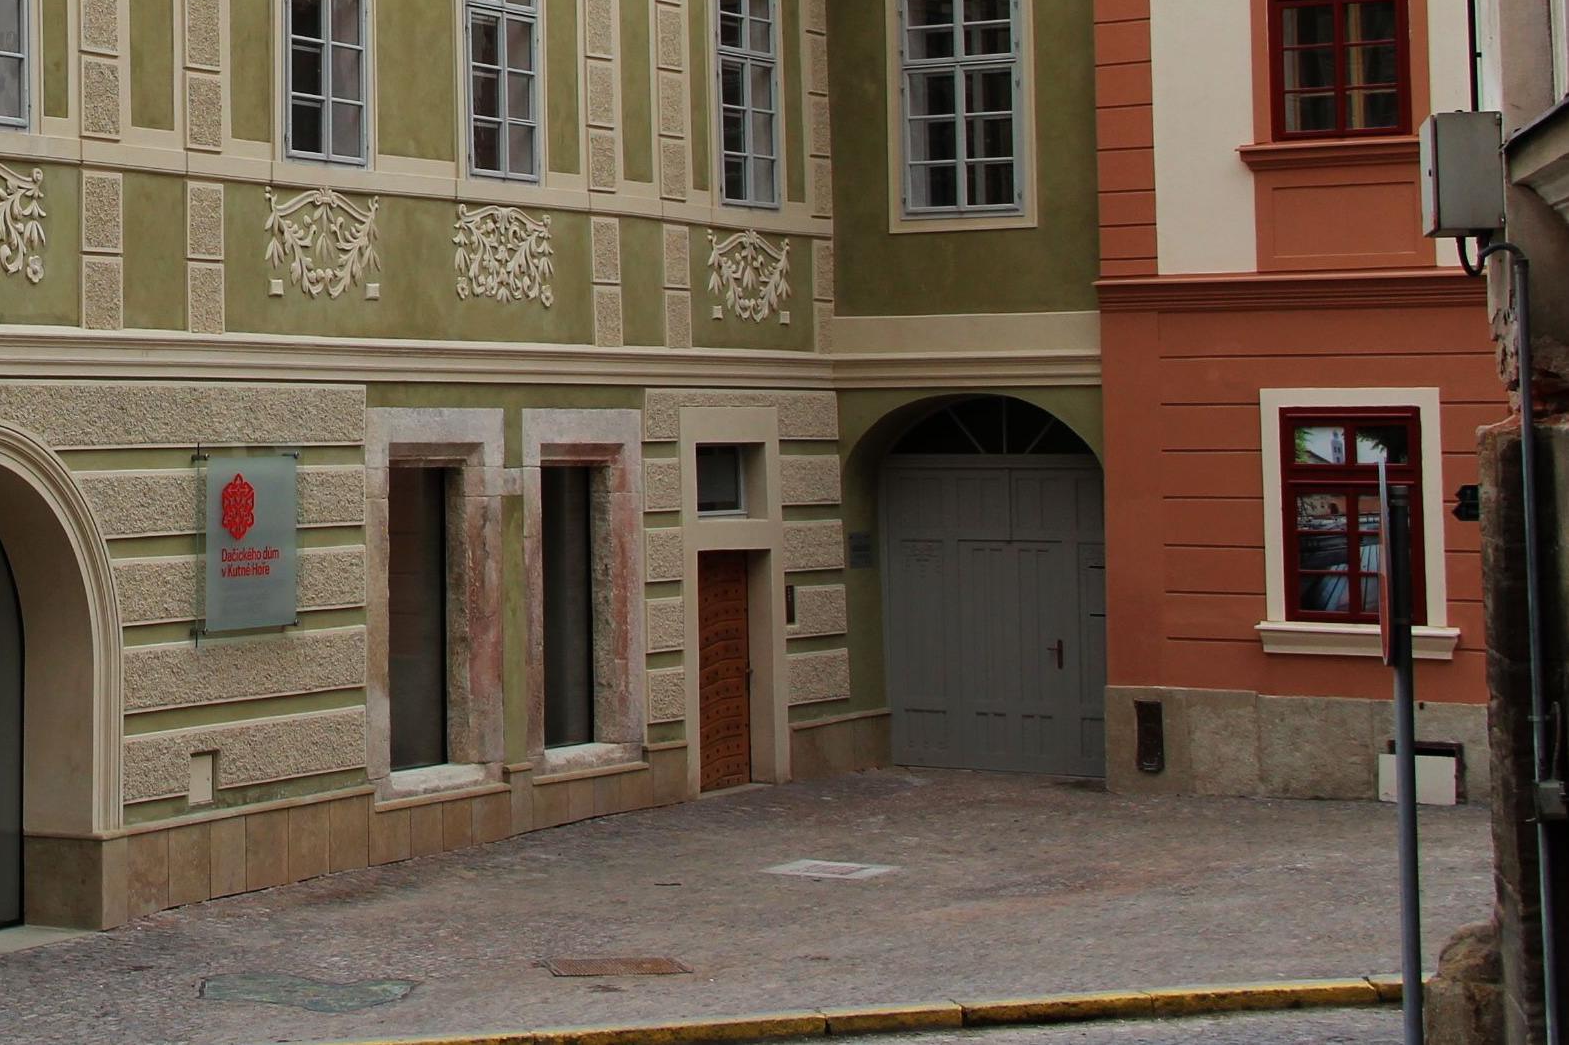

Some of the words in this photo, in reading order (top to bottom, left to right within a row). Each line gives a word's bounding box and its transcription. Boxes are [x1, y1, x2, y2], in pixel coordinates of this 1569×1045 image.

[221, 547, 262, 562] Dačického
[263, 546, 279, 560] dům
[227, 563, 251, 577] Kutné
[252, 562, 270, 576] Hoře
